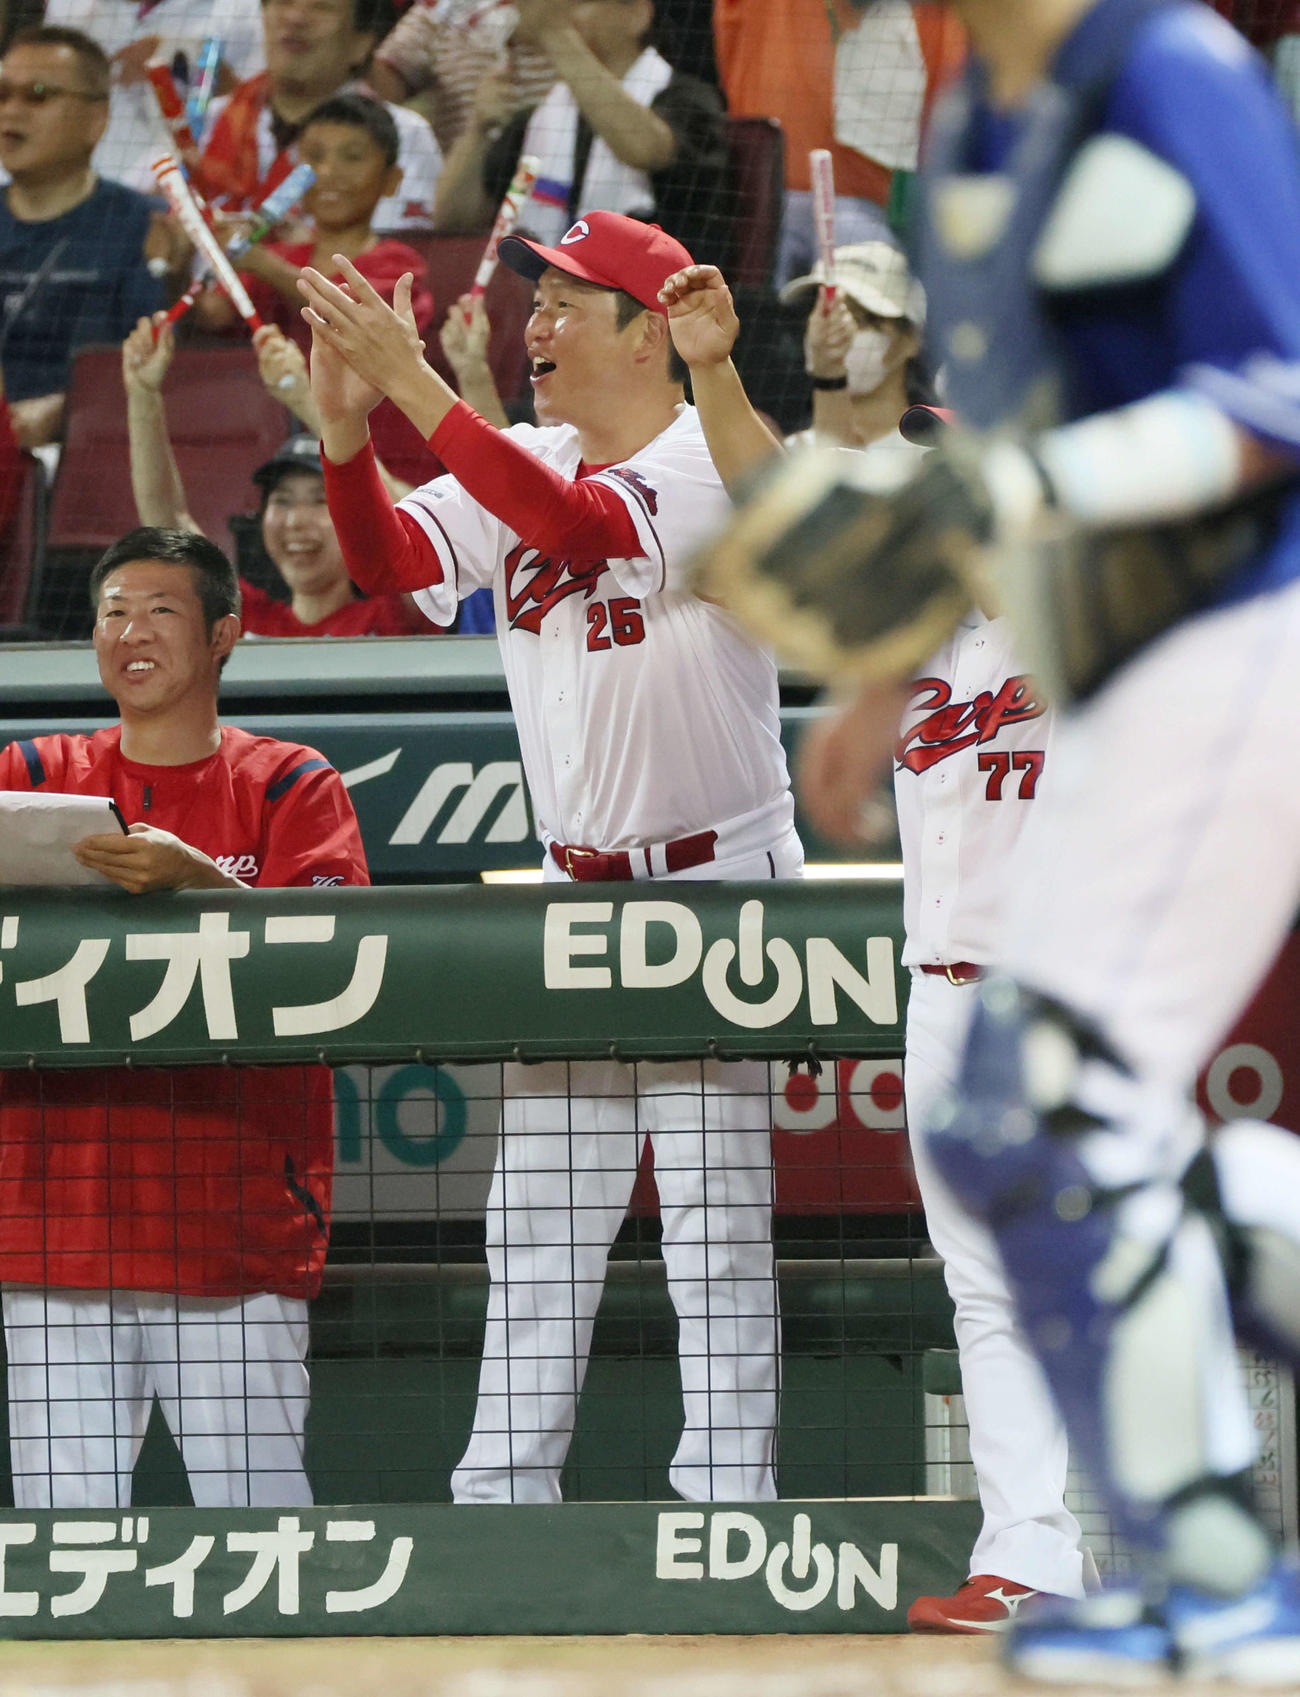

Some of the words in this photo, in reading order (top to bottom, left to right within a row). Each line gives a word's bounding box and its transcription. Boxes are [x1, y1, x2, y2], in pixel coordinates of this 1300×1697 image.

[560, 220, 589, 245] C
[587, 597, 646, 652] 25
[895, 674, 1048, 776] Carp
[977, 750, 1045, 801] 77
[0, 912, 389, 1043] ィオン
[544, 900, 898, 1028] EDION
[656, 1511, 898, 1611] EDION
